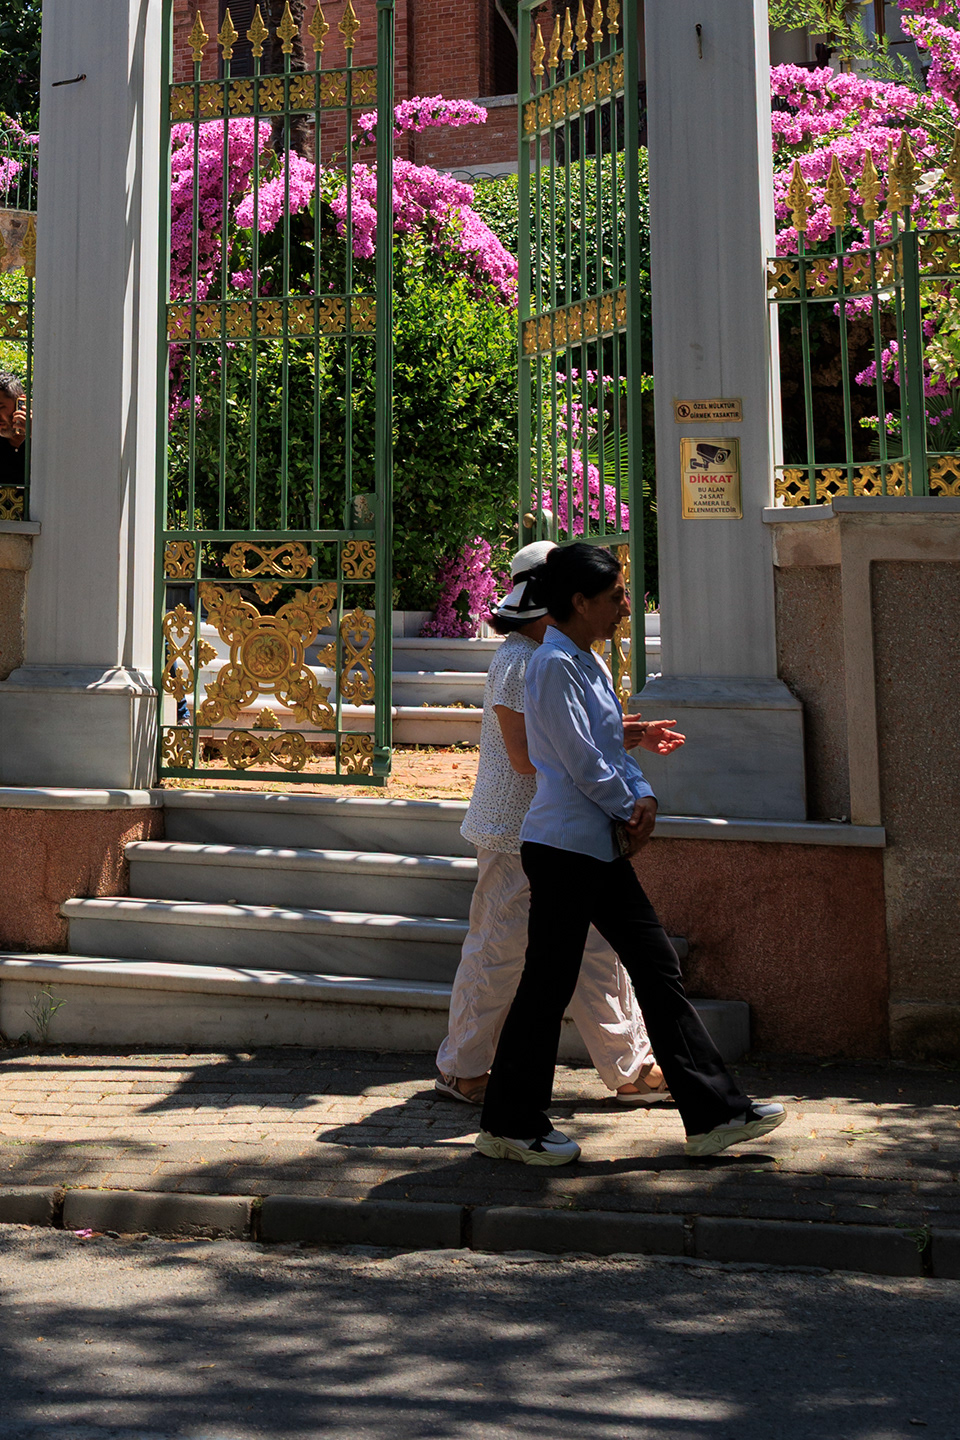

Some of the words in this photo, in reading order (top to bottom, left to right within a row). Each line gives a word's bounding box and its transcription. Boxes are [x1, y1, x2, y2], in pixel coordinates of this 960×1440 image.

[693, 402, 708, 410] ÖZEL
[709, 401, 735, 409] MÜLKTÜR
[690, 411, 711, 419] GİRMEK
[712, 411, 739, 419] YASAKTIR
[689, 474, 733, 484] DİKKAT
